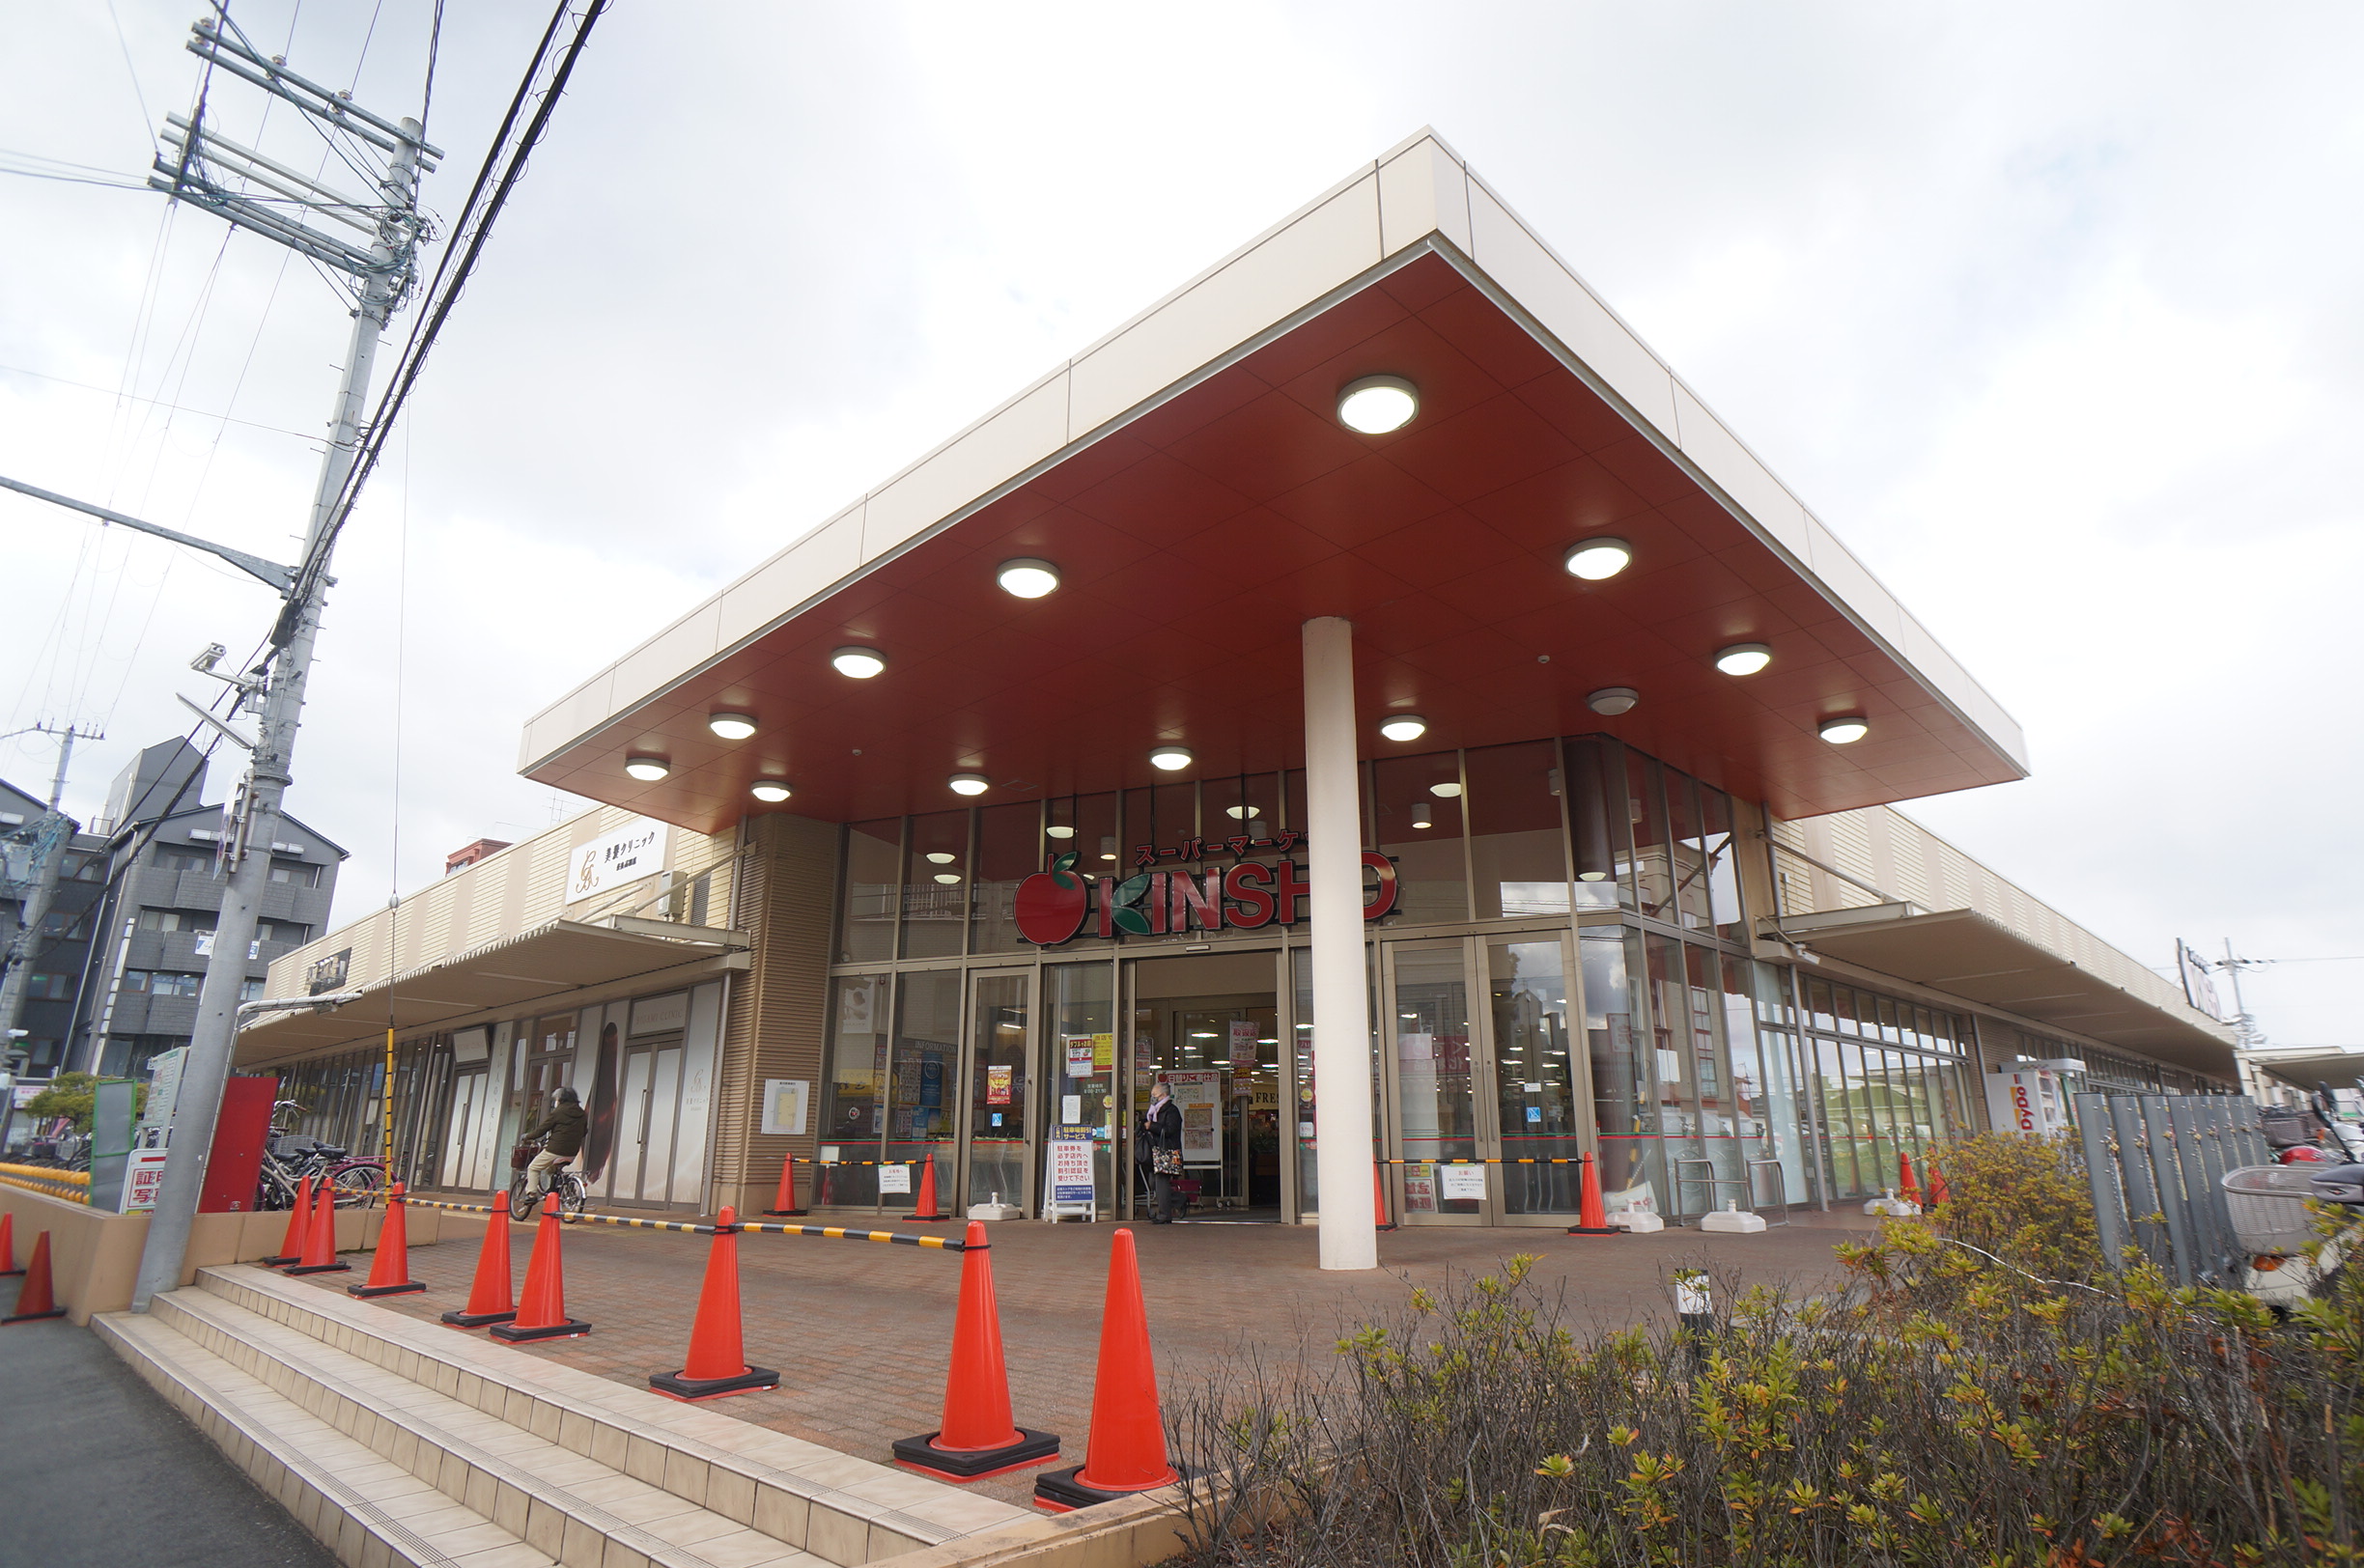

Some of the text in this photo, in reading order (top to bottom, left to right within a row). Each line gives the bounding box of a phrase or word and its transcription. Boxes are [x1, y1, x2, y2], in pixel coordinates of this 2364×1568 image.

[1136, 829, 1309, 866] スーパーマーケ
[915, 1041, 957, 1053] INFORMATION
[2015, 1086, 2035, 1131] DyDo
